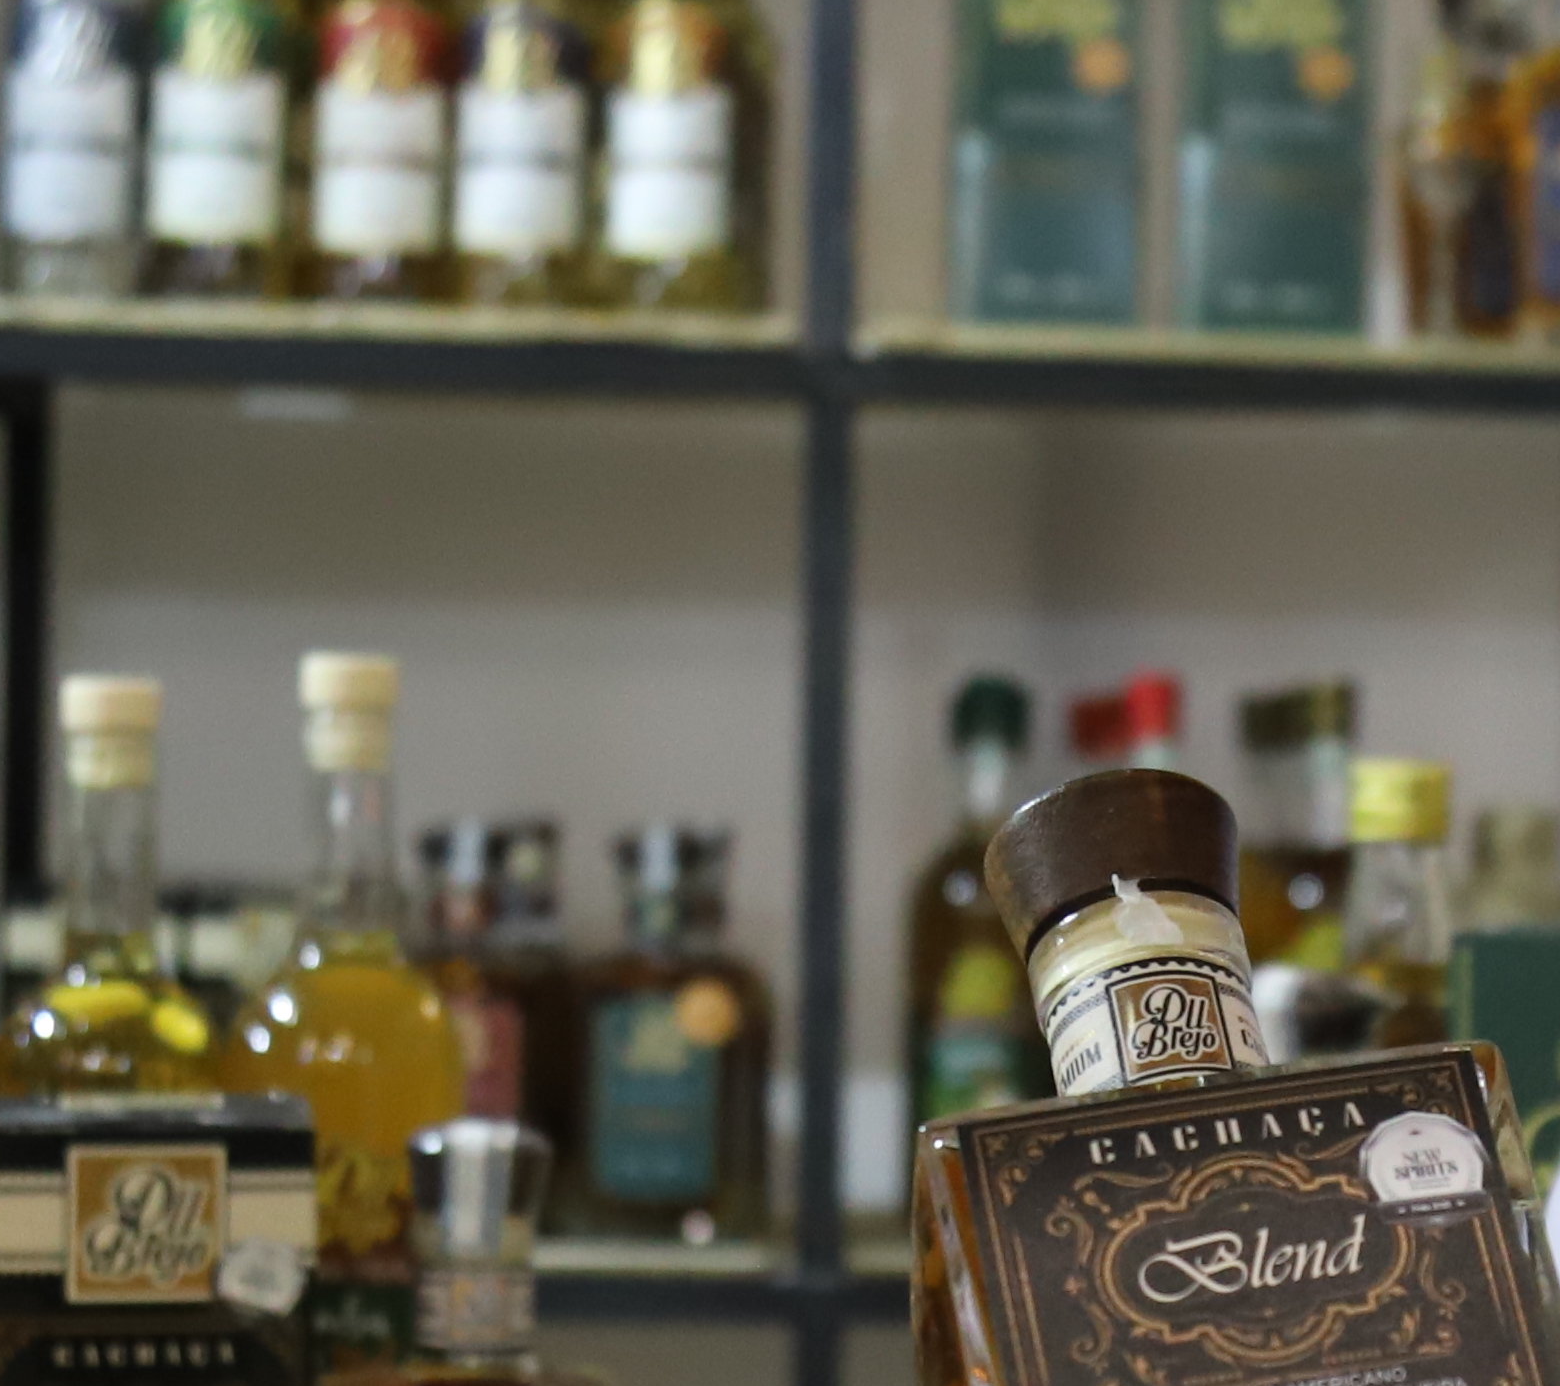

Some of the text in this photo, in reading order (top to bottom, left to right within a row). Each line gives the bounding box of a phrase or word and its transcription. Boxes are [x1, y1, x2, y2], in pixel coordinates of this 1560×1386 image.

[1131, 1020, 1217, 1060] Brejo
[1089, 1101, 1365, 1165] CACHAÇA
[1139, 1215, 1366, 1303] Blend
